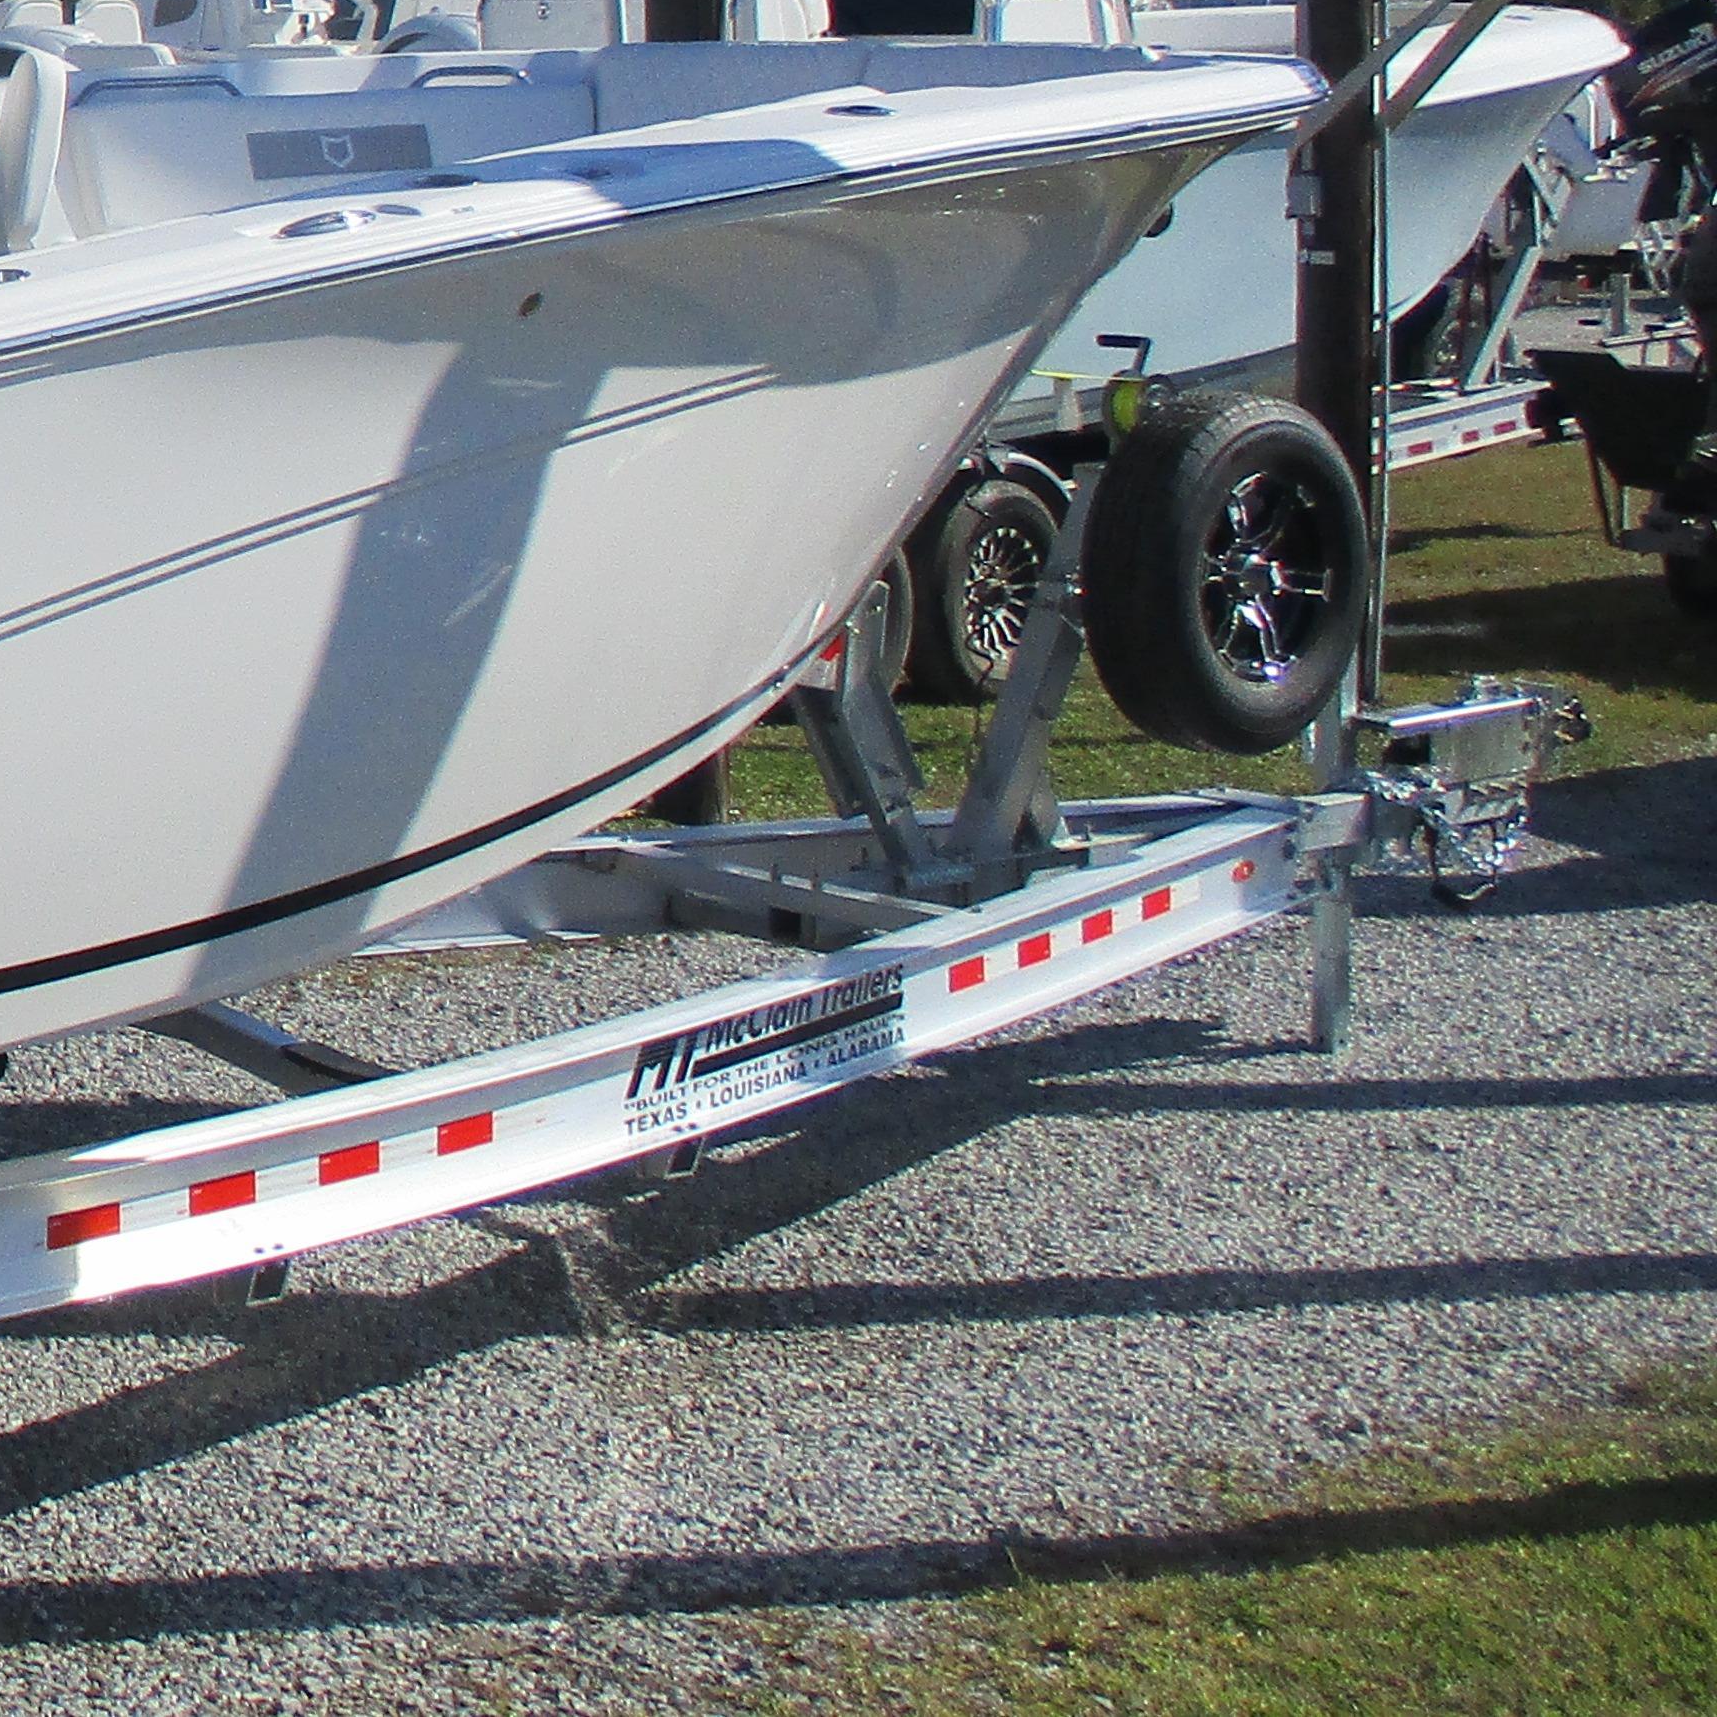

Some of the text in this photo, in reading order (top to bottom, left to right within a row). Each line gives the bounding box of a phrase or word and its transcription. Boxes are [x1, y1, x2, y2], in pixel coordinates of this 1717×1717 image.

[706, 963, 904, 1053] McClain Trailers
[624, 1026, 906, 1136] TEXAS LOUISIANA ALABAMA
[693, 1072, 732, 1093] FOR
[736, 1059, 768, 1078] THE
[776, 1037, 839, 1064] LONG
